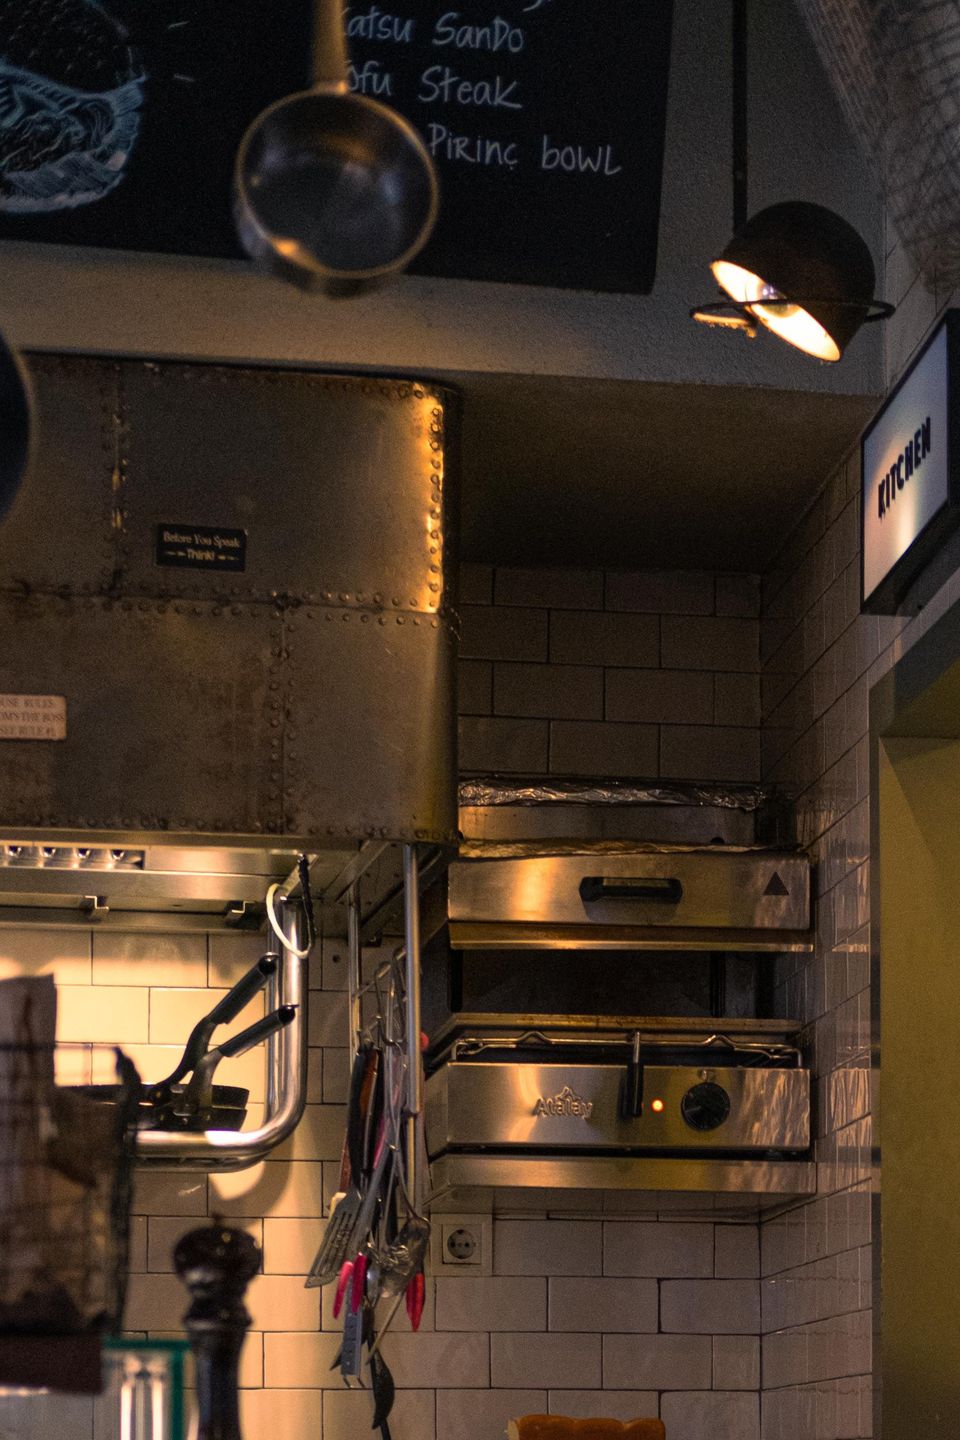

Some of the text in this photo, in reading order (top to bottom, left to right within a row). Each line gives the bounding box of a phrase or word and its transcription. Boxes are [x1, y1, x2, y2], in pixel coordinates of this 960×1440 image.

[341, 5, 413, 42] atsu
[877, 416, 931, 519] KITCHEN
[163, 530, 193, 544] Before
[194, 533, 213, 546] You
[532, 1092, 593, 1119] Atalay
